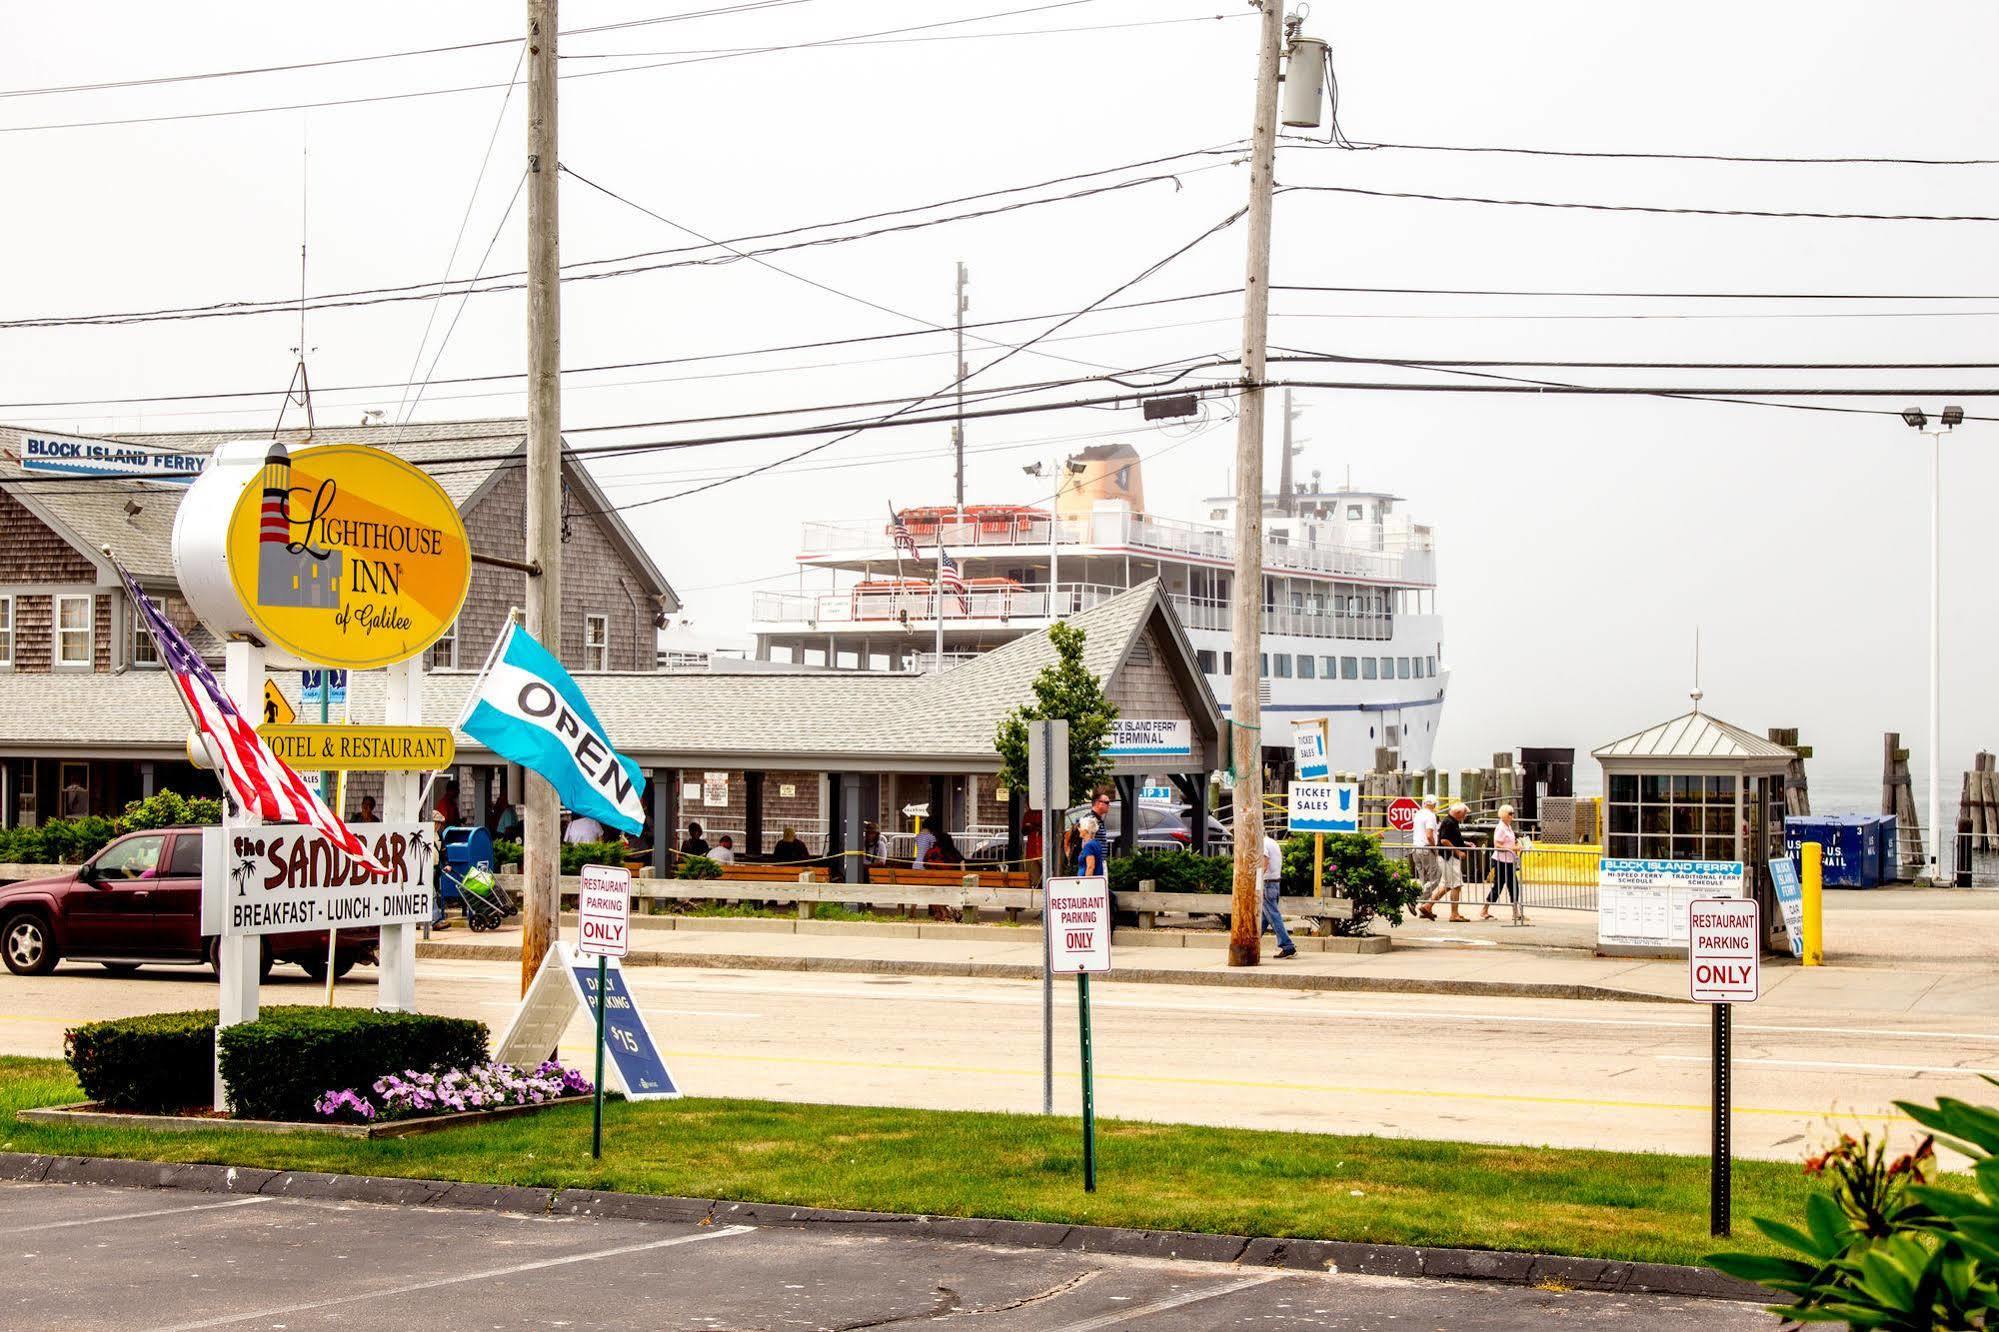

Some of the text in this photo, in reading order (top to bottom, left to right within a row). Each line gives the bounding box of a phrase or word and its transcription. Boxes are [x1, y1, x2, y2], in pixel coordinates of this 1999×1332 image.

[28, 439, 205, 472] BLOCK ISLAND FERRY
[280, 478, 443, 560] LIGHTHOUSE
[351, 559, 401, 595] INN
[335, 603, 412, 635] of Galilee
[1125, 722, 1152, 731] ISLAND
[1153, 722, 1177, 732] FERRY
[518, 682, 633, 805] OPEN
[1113, 732, 1164, 744] TERMINAL
[322, 737, 335, 757] &
[340, 737, 447, 758] RESTAURANT
[1301, 749, 1315, 758] SALES
[300, 775, 319, 783] ALES
[1295, 787, 1332, 798] TICKET
[1297, 800, 1329, 811] SALES
[1390, 807, 1419, 821] STOP
[1856, 827, 1863, 835] 3
[234, 836, 266, 857] the
[1605, 860, 1738, 872] BLOCK ISLAND FERRY
[583, 878, 627, 894] RESTAURANT
[234, 900, 316, 928] BREAKFAST
[327, 897, 371, 920] LUNCH
[383, 893, 429, 916] DINNER
[586, 897, 623, 912] PARKING
[1051, 897, 1105, 910] RESTAURANT
[1061, 911, 1097, 923] PARKING
[1692, 914, 1754, 928] RESTAURANT
[583, 922, 624, 941] ONLY
[1066, 932, 1093, 949] ONLY
[1698, 936, 1749, 949] PARKING
[1696, 965, 1752, 984] ONLY
[610, 1025, 640, 1053] $15
